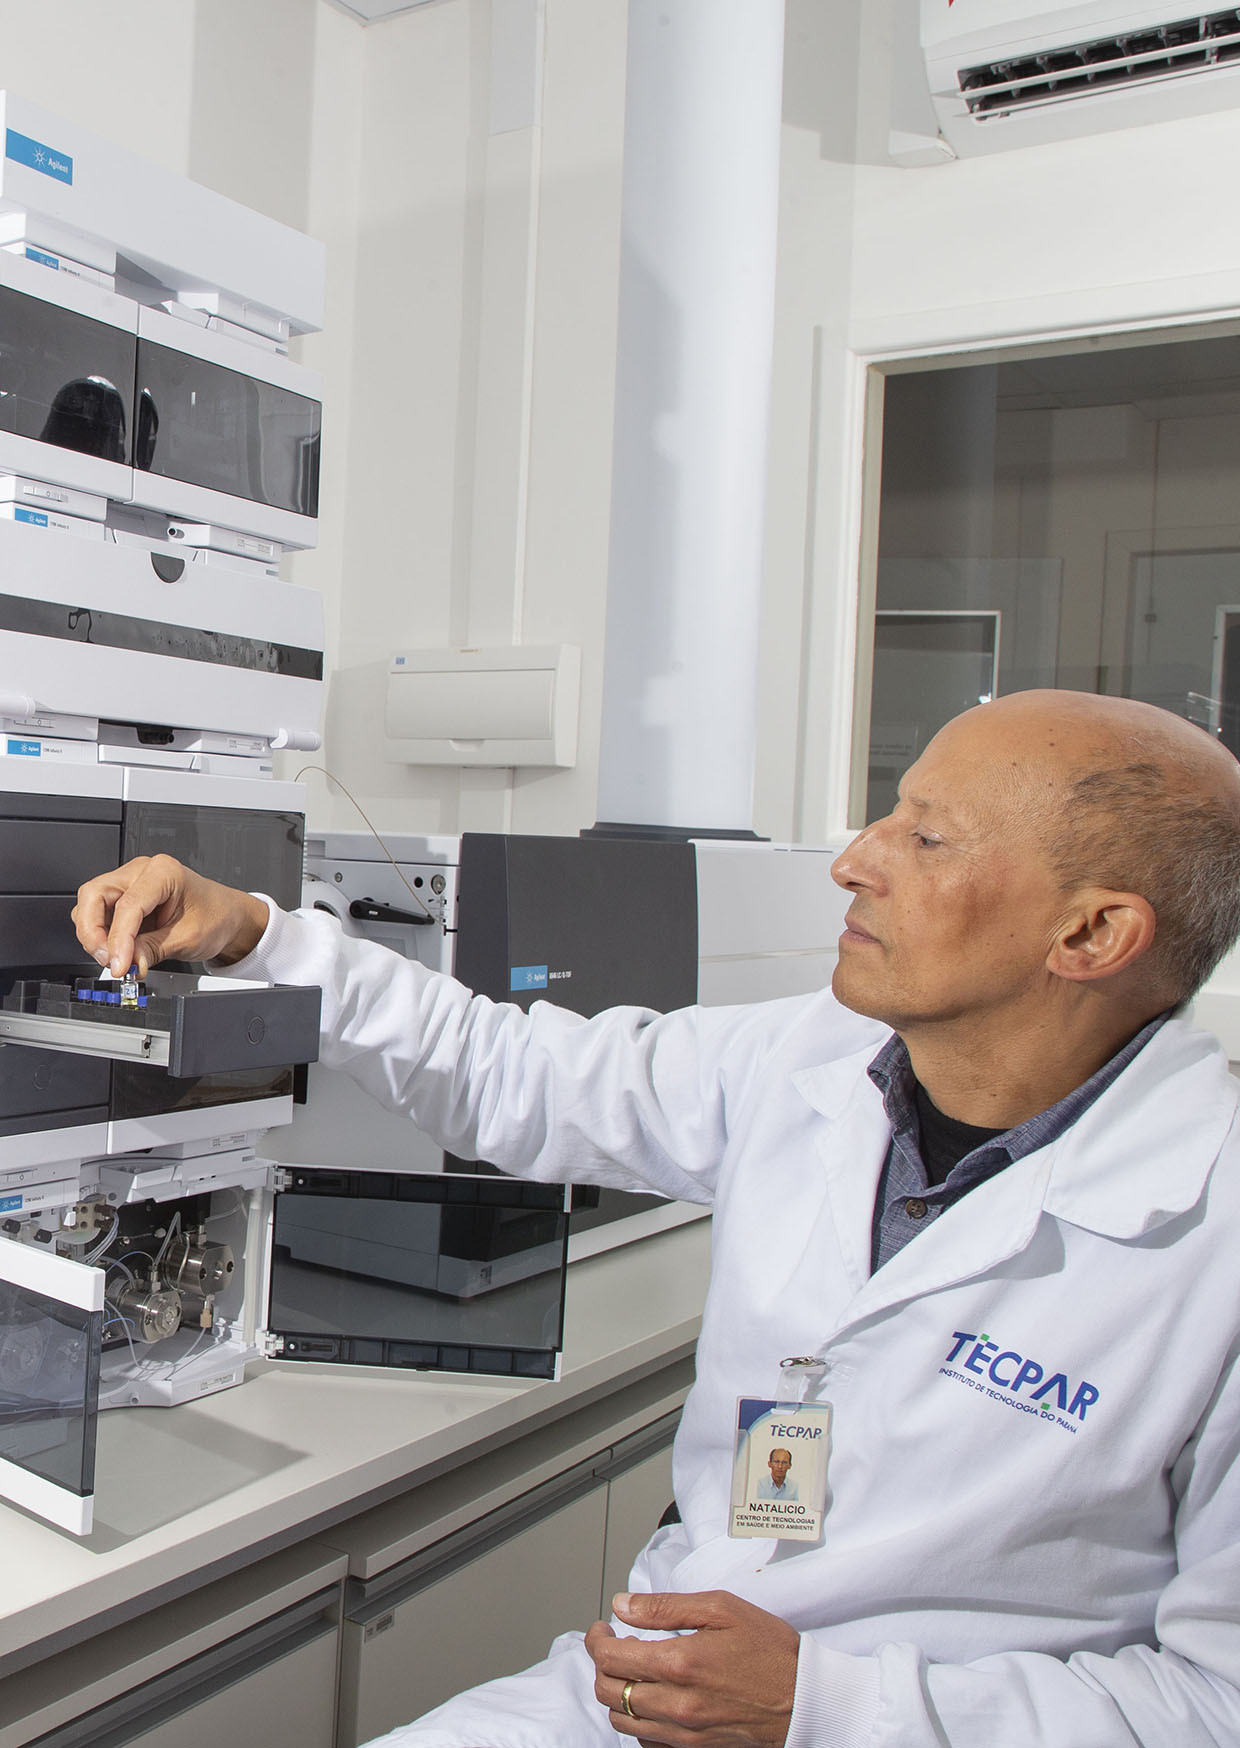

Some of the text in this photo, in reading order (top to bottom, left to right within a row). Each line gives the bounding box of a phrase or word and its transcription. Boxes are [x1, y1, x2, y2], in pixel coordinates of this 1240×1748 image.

[48, 157, 69, 174] Agilent
[938, 1367, 975, 1388] INSTITUTO
[974, 1382, 985, 1394] DE
[985, 1388, 1038, 1416] TECNOLOGIA
[1039, 1410, 1056, 1422] DO
[749, 1503, 806, 1515] NATALICIO
[736, 1514, 815, 1525] CENTRO DE TECNOLOGIAS
[786, 1523, 815, 1531] AMBIENTE
